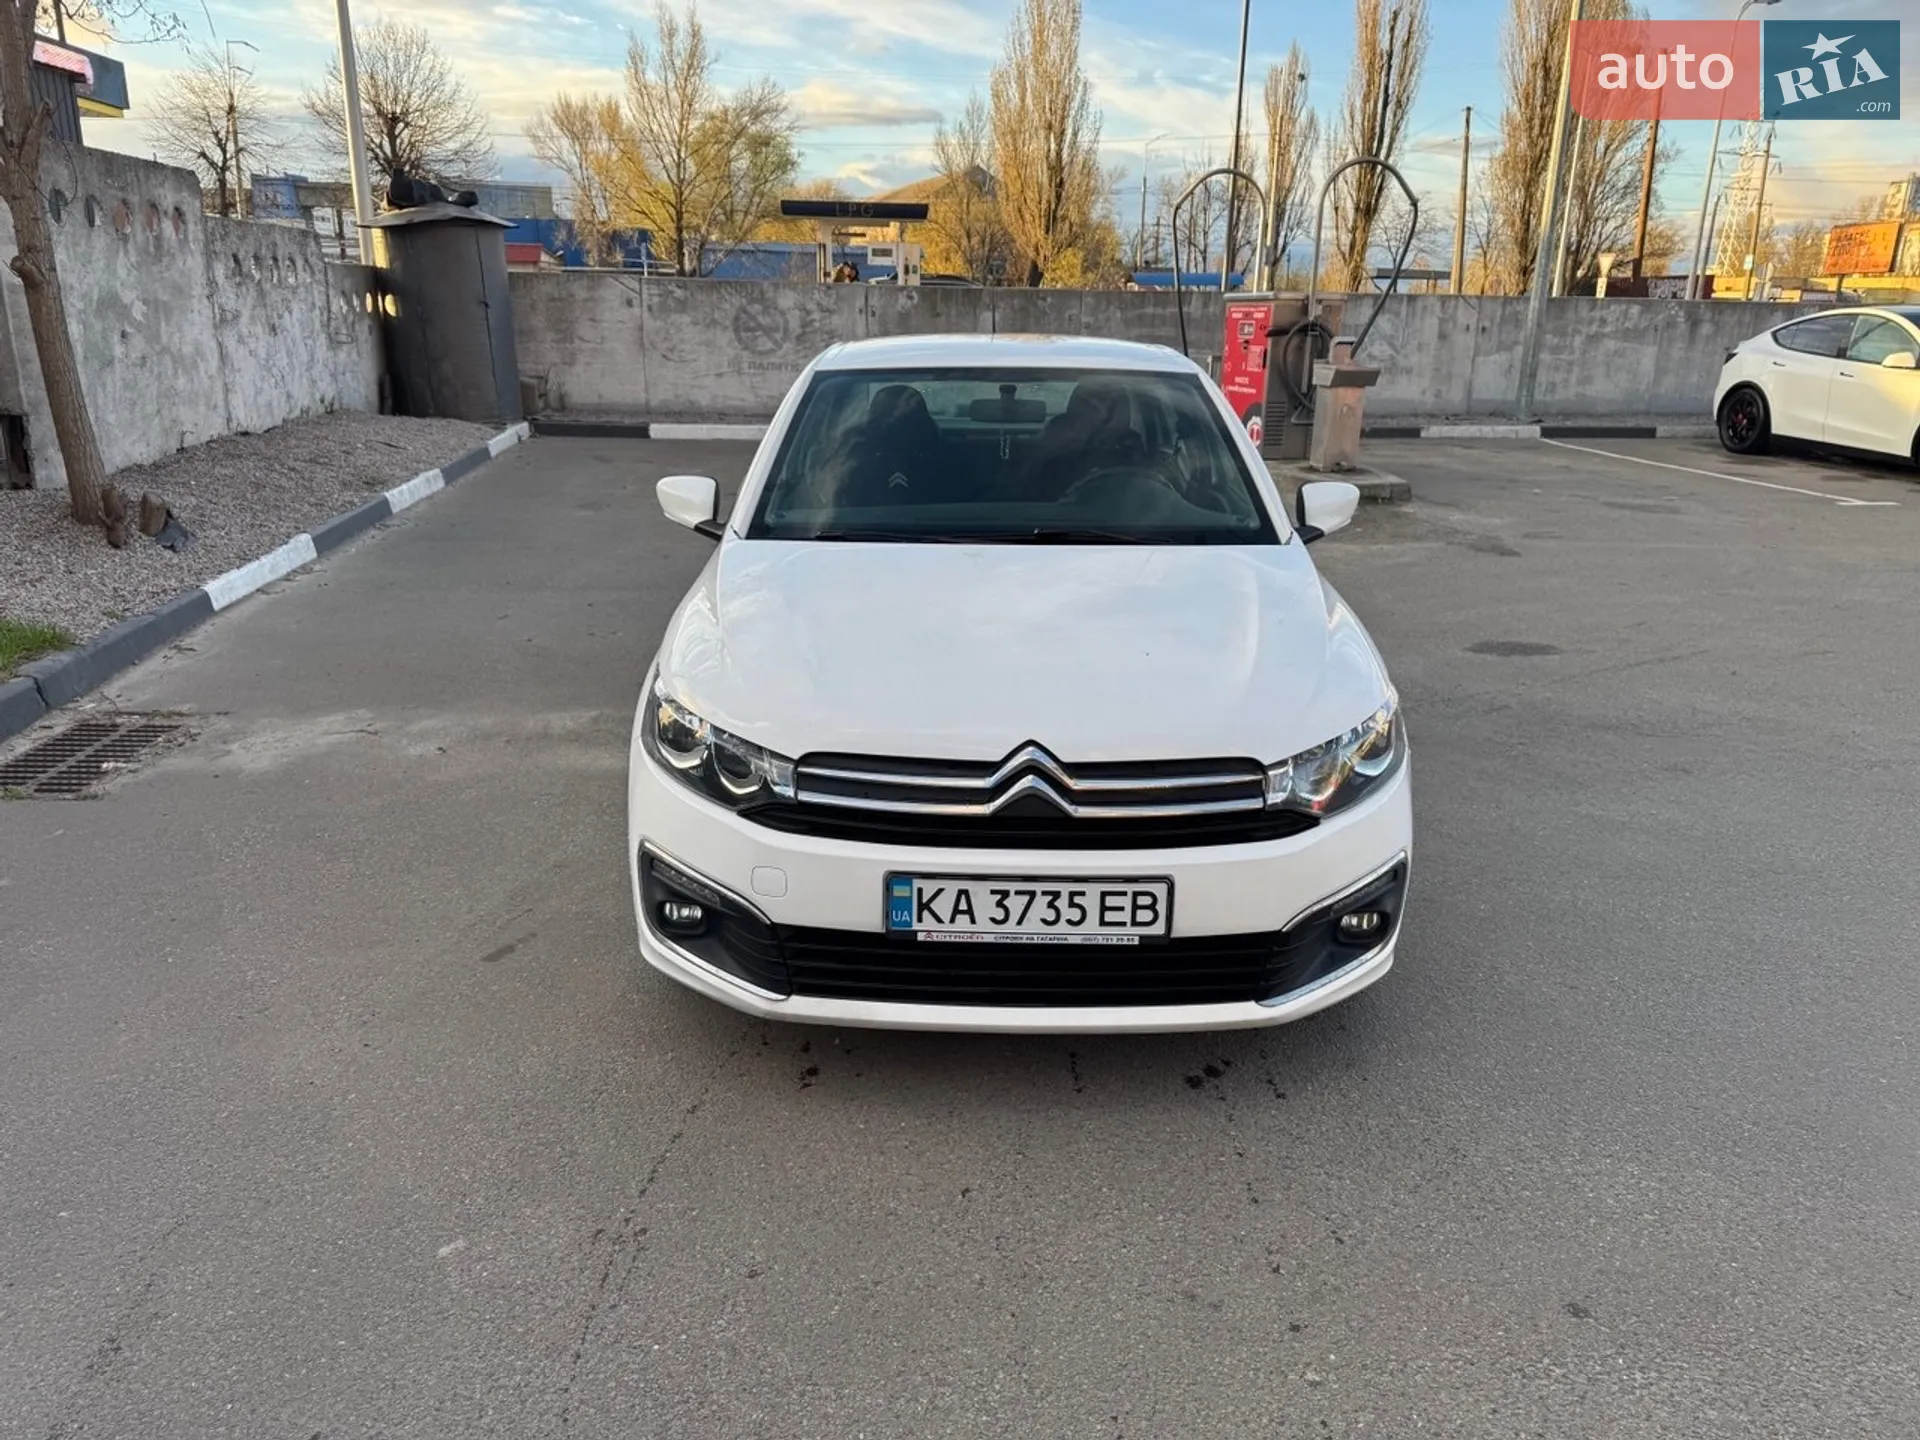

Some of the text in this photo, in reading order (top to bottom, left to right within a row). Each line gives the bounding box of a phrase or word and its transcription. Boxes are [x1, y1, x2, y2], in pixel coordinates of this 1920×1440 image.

[836, 203, 874, 217] LPG
[916, 887, 1160, 927] KA 3735 EB
[892, 911, 910, 922] UA
